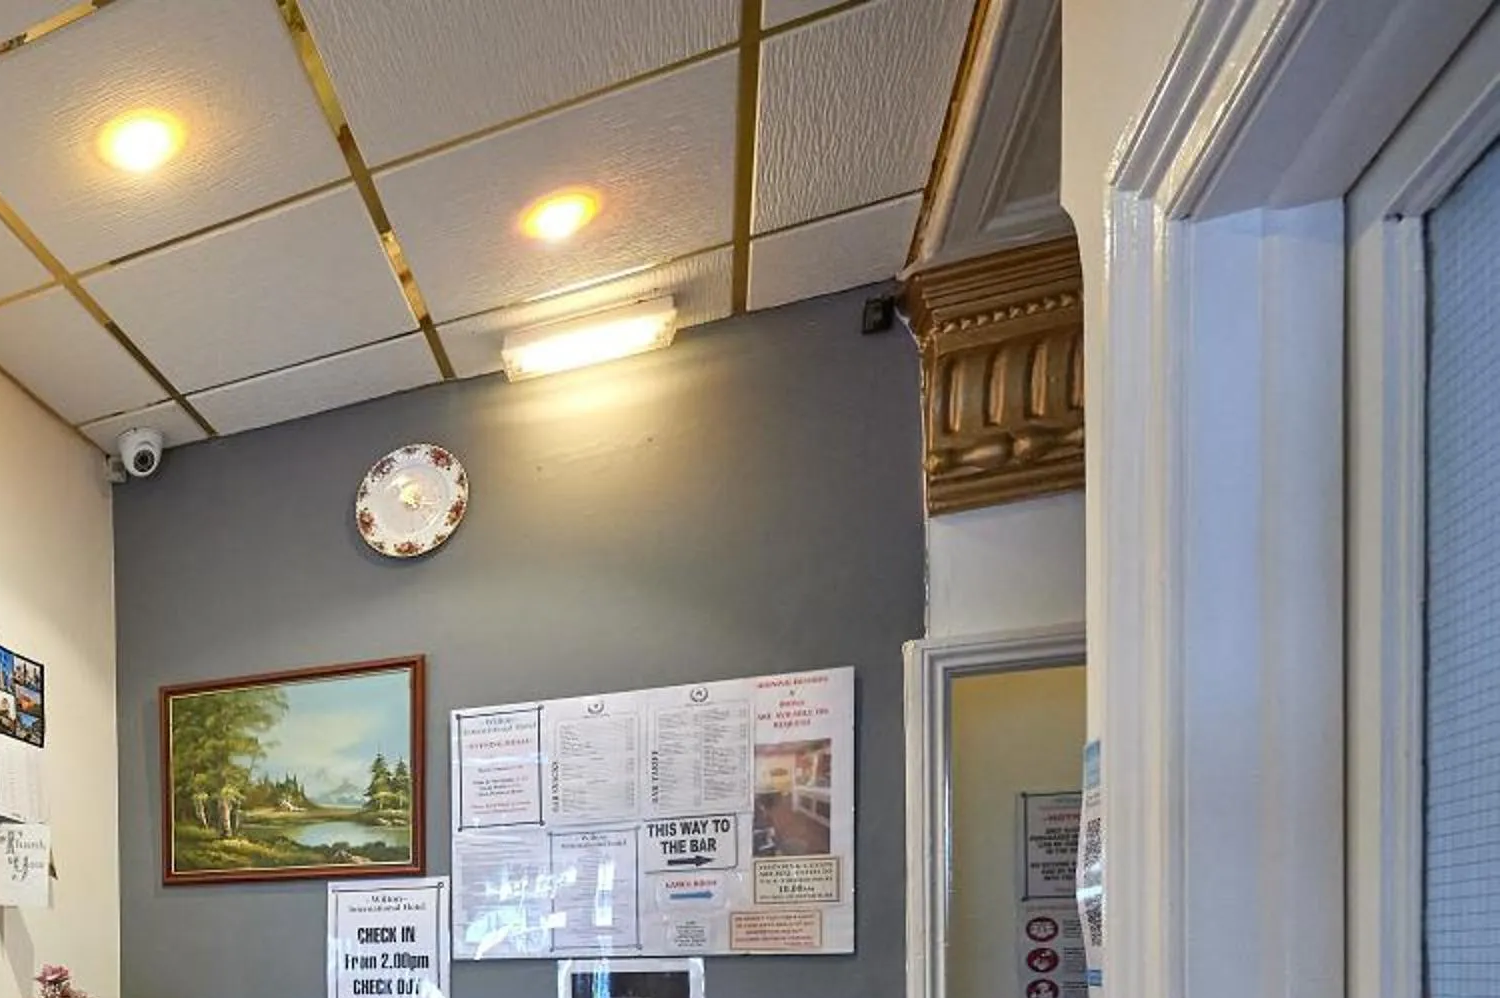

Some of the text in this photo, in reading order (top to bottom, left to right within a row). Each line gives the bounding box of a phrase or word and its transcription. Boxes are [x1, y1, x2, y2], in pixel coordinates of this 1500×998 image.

[646, 818, 730, 838] THIS WAY TO
[660, 837, 717, 855] THE BAR
[357, 926, 416, 944] CHECK IN
[381, 952, 430, 972] 2.00pm
[353, 979, 393, 995] CHECK
